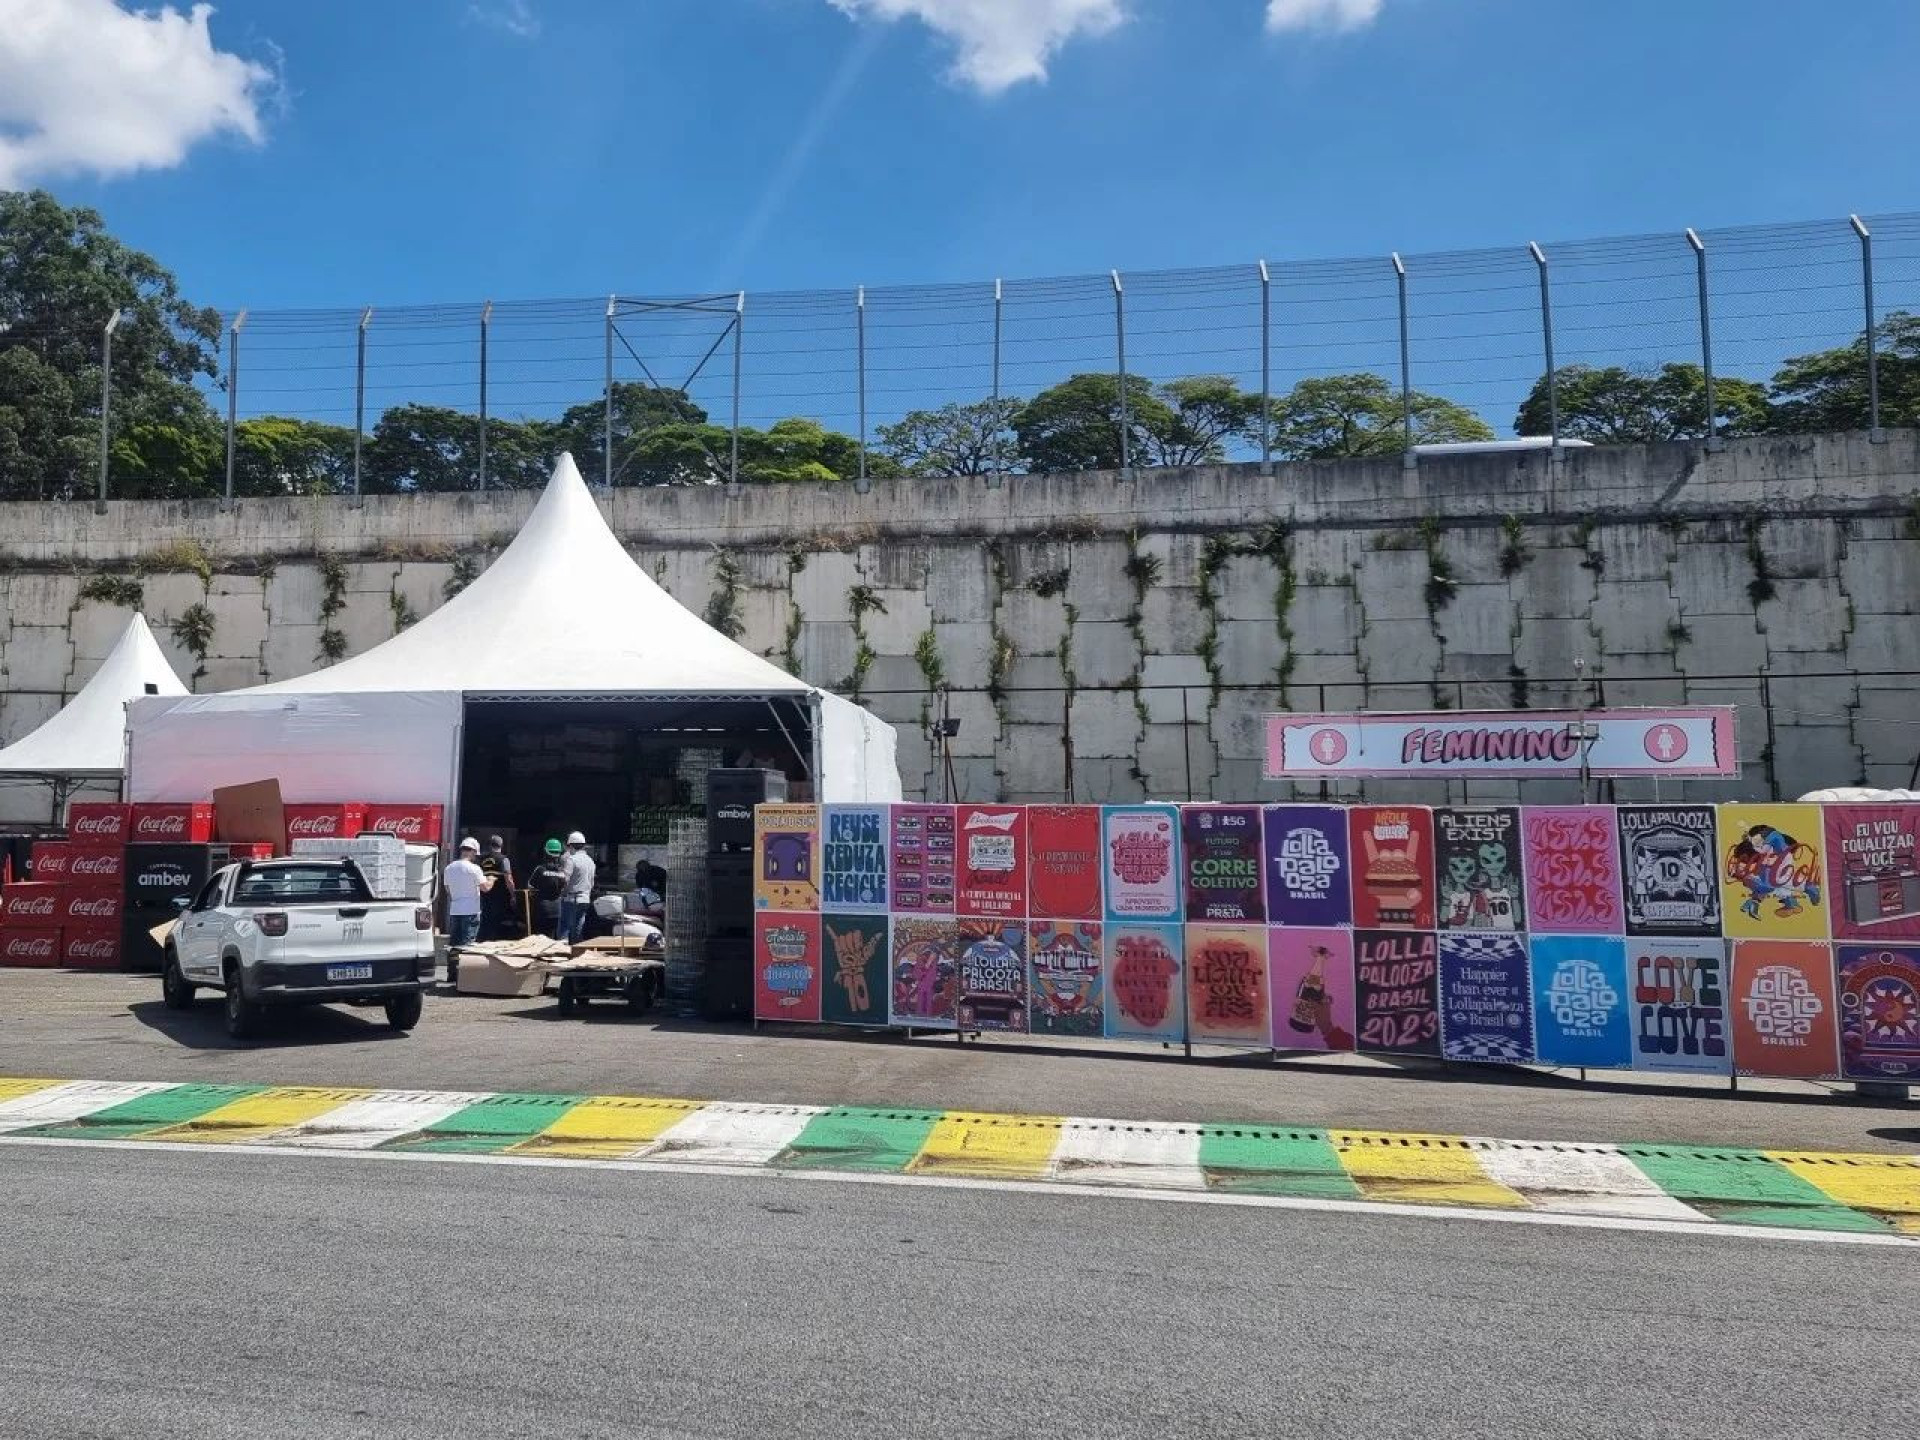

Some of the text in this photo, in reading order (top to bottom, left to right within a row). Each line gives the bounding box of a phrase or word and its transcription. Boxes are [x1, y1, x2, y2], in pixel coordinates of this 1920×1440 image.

[1401, 727, 1578, 763] FEMININO
[717, 809, 751, 819] ambev
[1441, 814, 1512, 827] ALIENS
[1620, 812, 1713, 829] LOLLAPALOOZA
[830, 814, 879, 843] REUSE
[1446, 828, 1506, 840] EXIST
[1856, 820, 1898, 837] EU VOU
[1842, 833, 1914, 853] EQUALIZAR
[824, 844, 886, 873] REDUZA
[1191, 860, 1257, 875] CORRE
[1660, 862, 1680, 877] 10
[138, 871, 192, 886] ambev
[1191, 877, 1257, 888] COLETIVO
[823, 873, 886, 903] RECICLE
[1290, 891, 1328, 899] BRASIL
[1490, 901, 1510, 915] 10
[1360, 935, 1436, 963] LOLLA
[974, 956, 1009, 968] LOLLA
[963, 967, 1021, 981] PALOOZA
[1360, 960, 1435, 987] PALOOZA
[1460, 967, 1509, 984] Happier
[970, 980, 1014, 991] BRASIL
[1452, 981, 1480, 995] than
[1482, 986, 1509, 996] ever
[1636, 957, 1722, 1006] LOVE
[1368, 988, 1431, 1009] BRASIL
[1469, 1012, 1504, 1026] Brasil
[1361, 1011, 1438, 1046] 2023
[1562, 1028, 1604, 1037] BRASIL
[1639, 1005, 1725, 1056] LOVE
[1762, 1037, 1808, 1047] BRASIL
